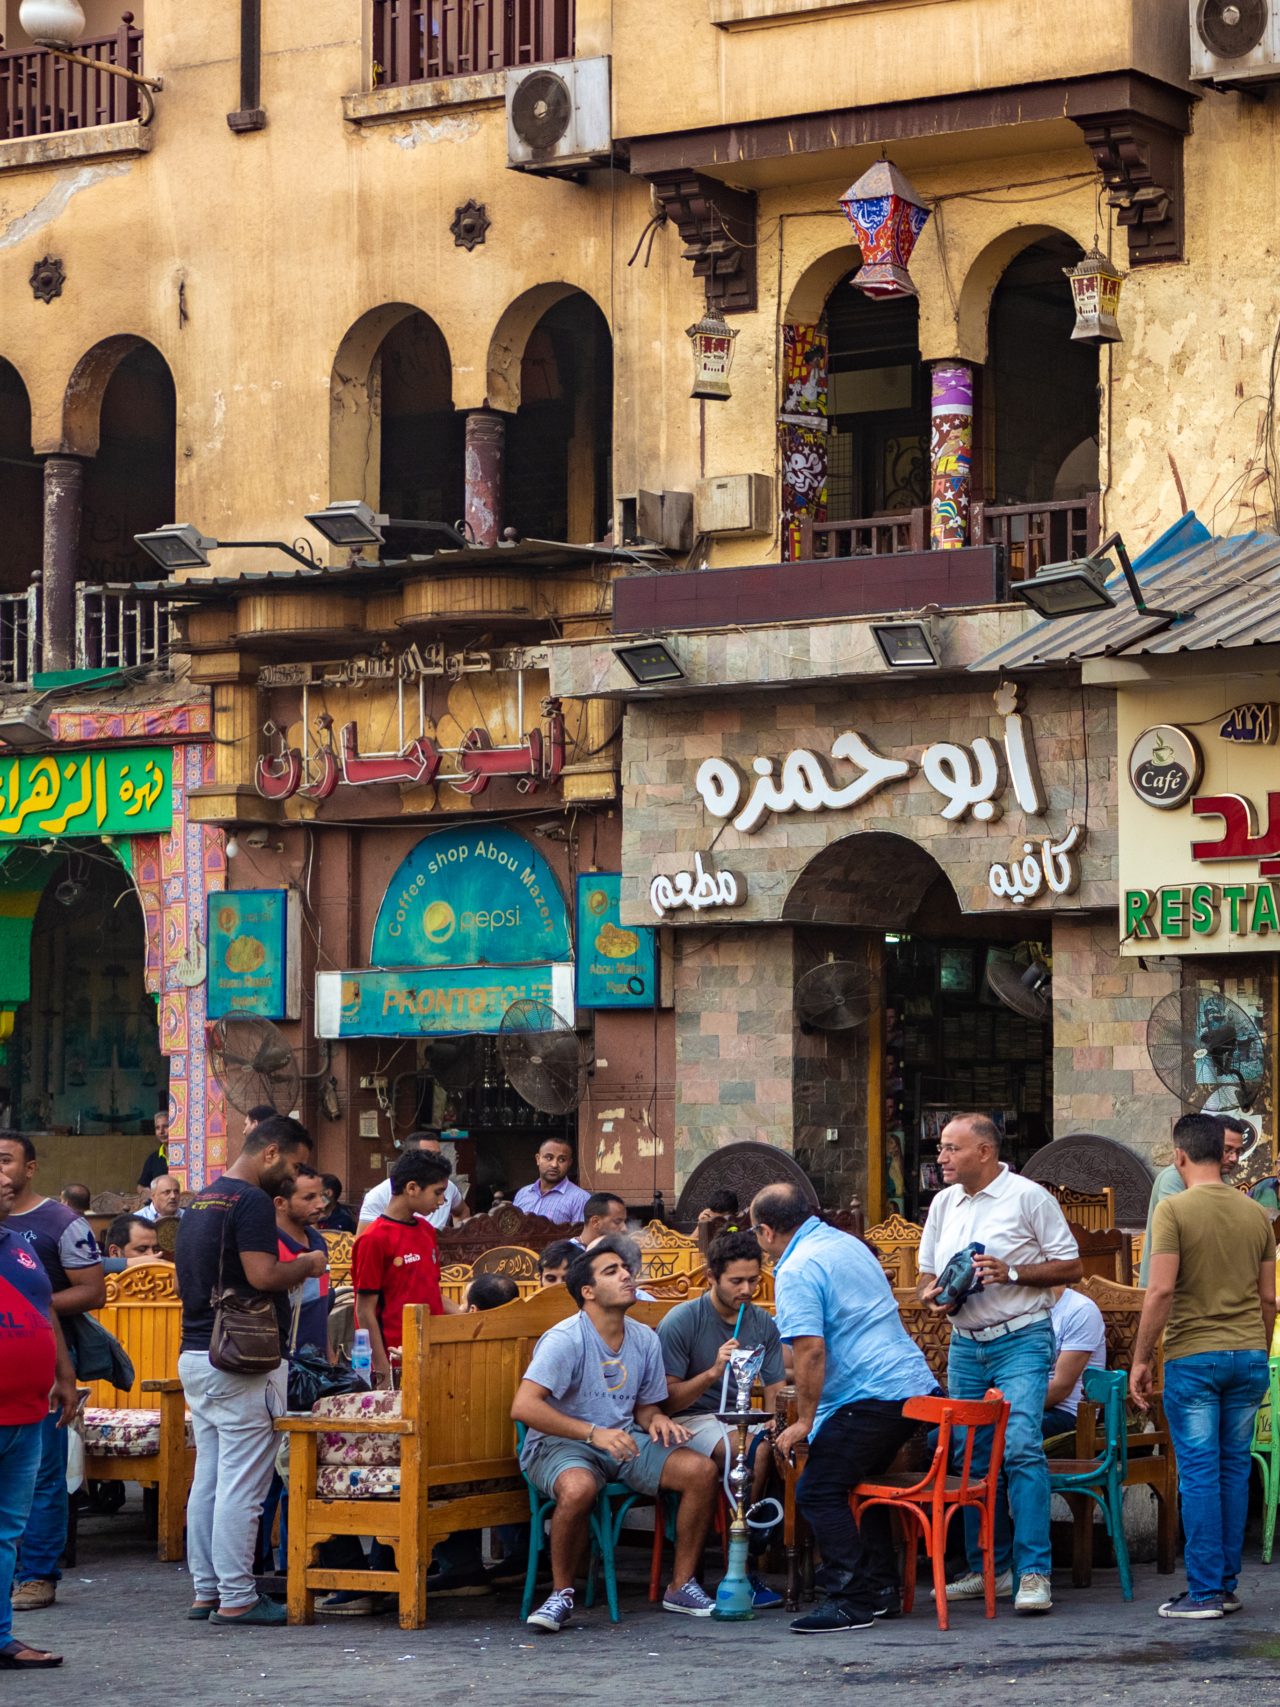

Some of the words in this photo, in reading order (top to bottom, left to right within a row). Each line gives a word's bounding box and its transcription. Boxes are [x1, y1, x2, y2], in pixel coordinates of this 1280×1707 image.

[922, 682, 1044, 822] أبو
[1218, 703, 1273, 744] الله
[119, 760, 164, 816] قهوة
[1141, 770, 1183, 796] Café
[388, 874, 427, 937] Coffee
[428, 844, 469, 874] shop
[474, 840, 519, 872] Abou
[520, 867, 555, 933] Mazen
[650, 853, 742, 919] مطعم
[988, 824, 1083, 905] كافيه
[459, 905, 521, 932] pepsi
